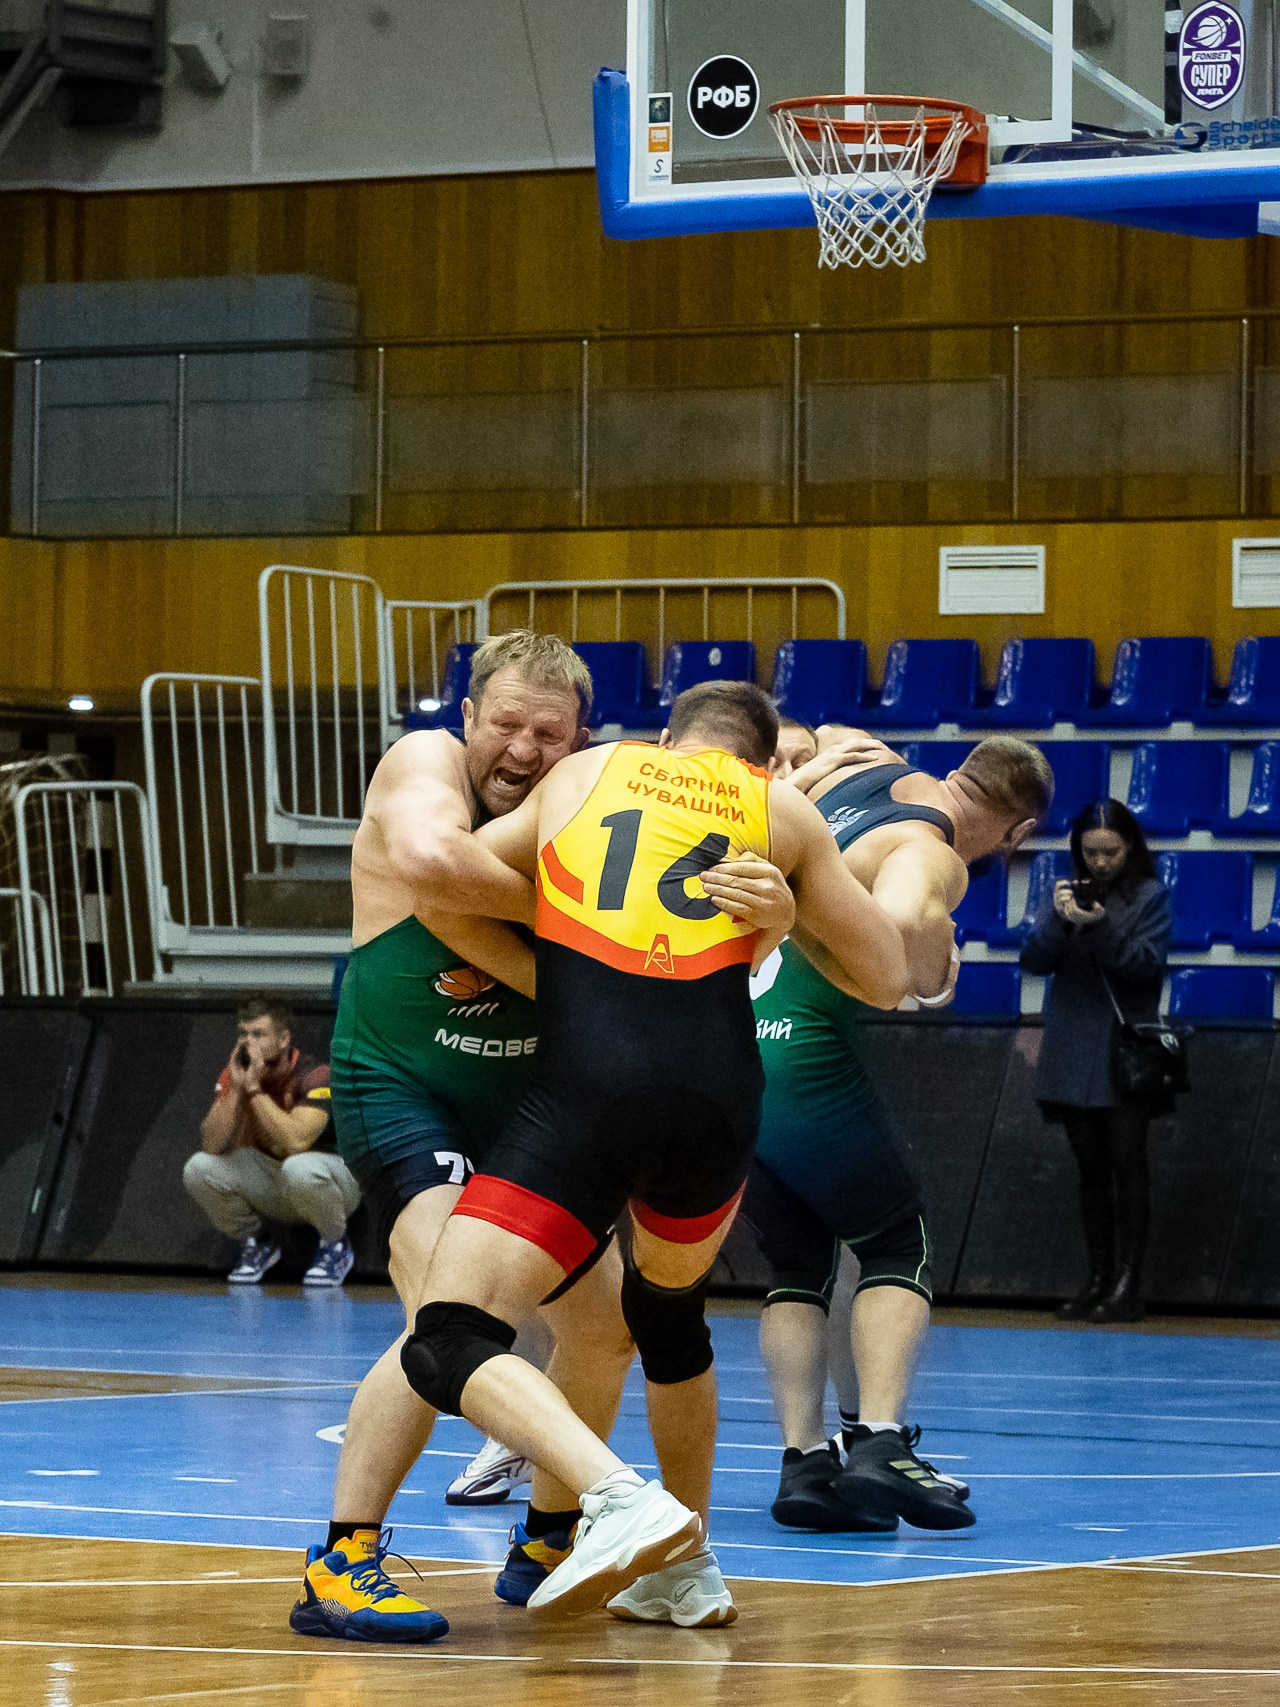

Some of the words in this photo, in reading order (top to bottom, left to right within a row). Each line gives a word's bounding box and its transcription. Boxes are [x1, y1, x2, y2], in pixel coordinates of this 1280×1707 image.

[1194, 51, 1228, 60] FONBET
[1191, 63, 1232, 87] СУПЕР
[697, 84, 751, 109] РФБ
[639, 763, 740, 799] СБОРНАЯ
[627, 780, 745, 824] ЧУВАШИИ
[597, 809, 731, 920] 16
